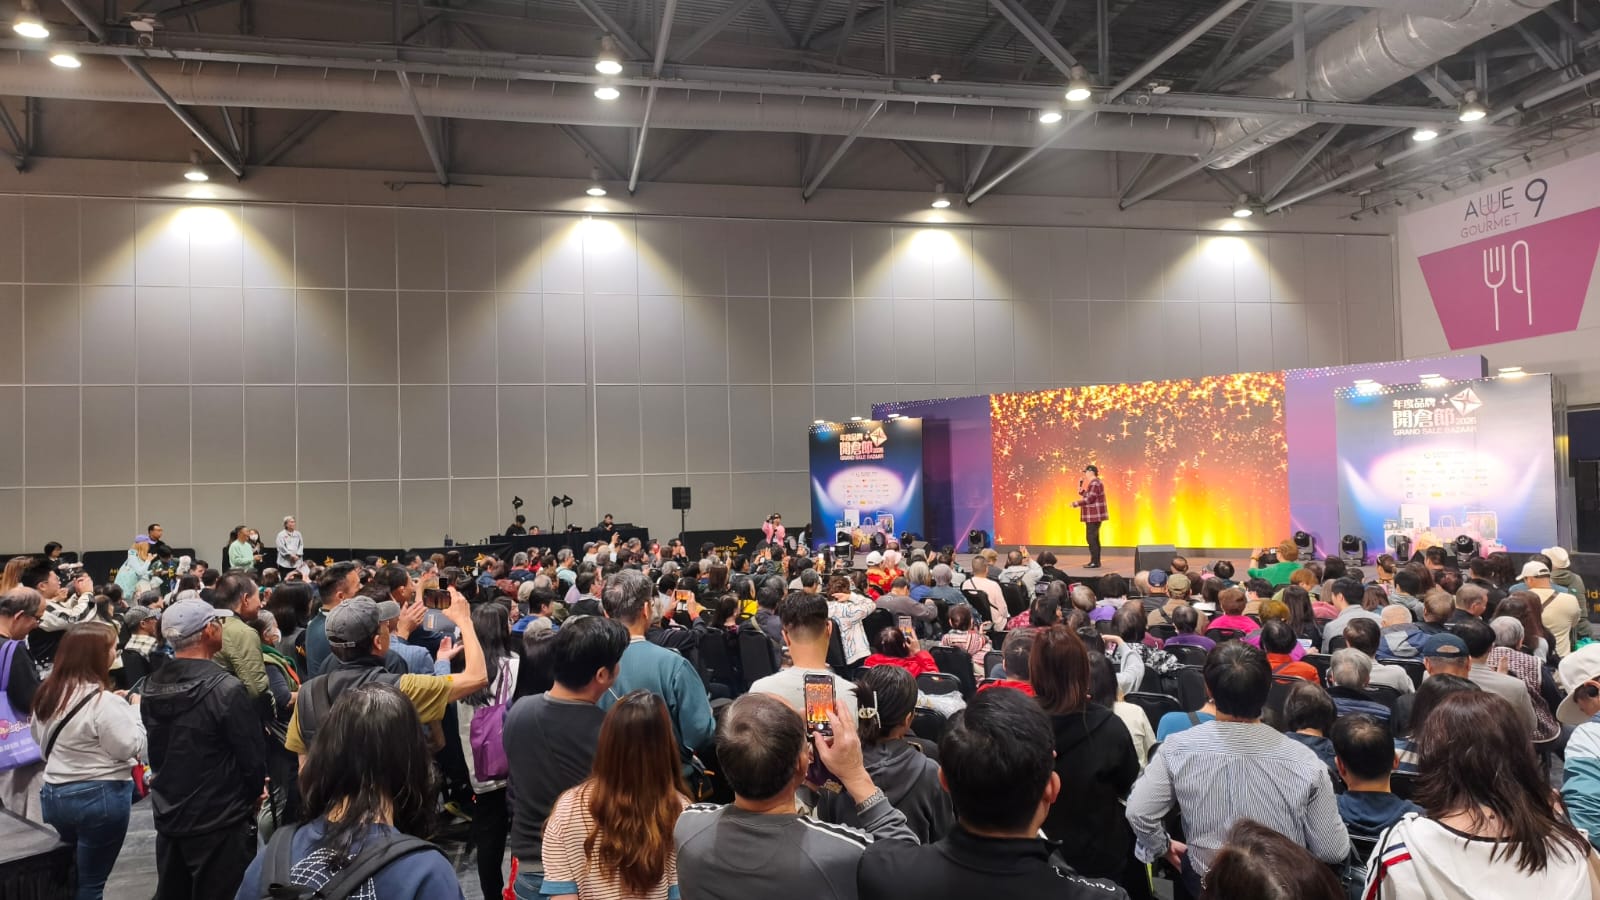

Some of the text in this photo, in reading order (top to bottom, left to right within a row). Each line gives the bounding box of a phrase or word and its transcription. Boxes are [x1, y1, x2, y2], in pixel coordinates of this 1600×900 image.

[1525, 178, 1548, 218] 9
[1460, 212, 1521, 238] GOURMET
[1393, 398, 1436, 409] 年度品牌
[1392, 408, 1455, 428] 開倉節
[1393, 425, 1478, 436] GRAND SALE BAZAAR
